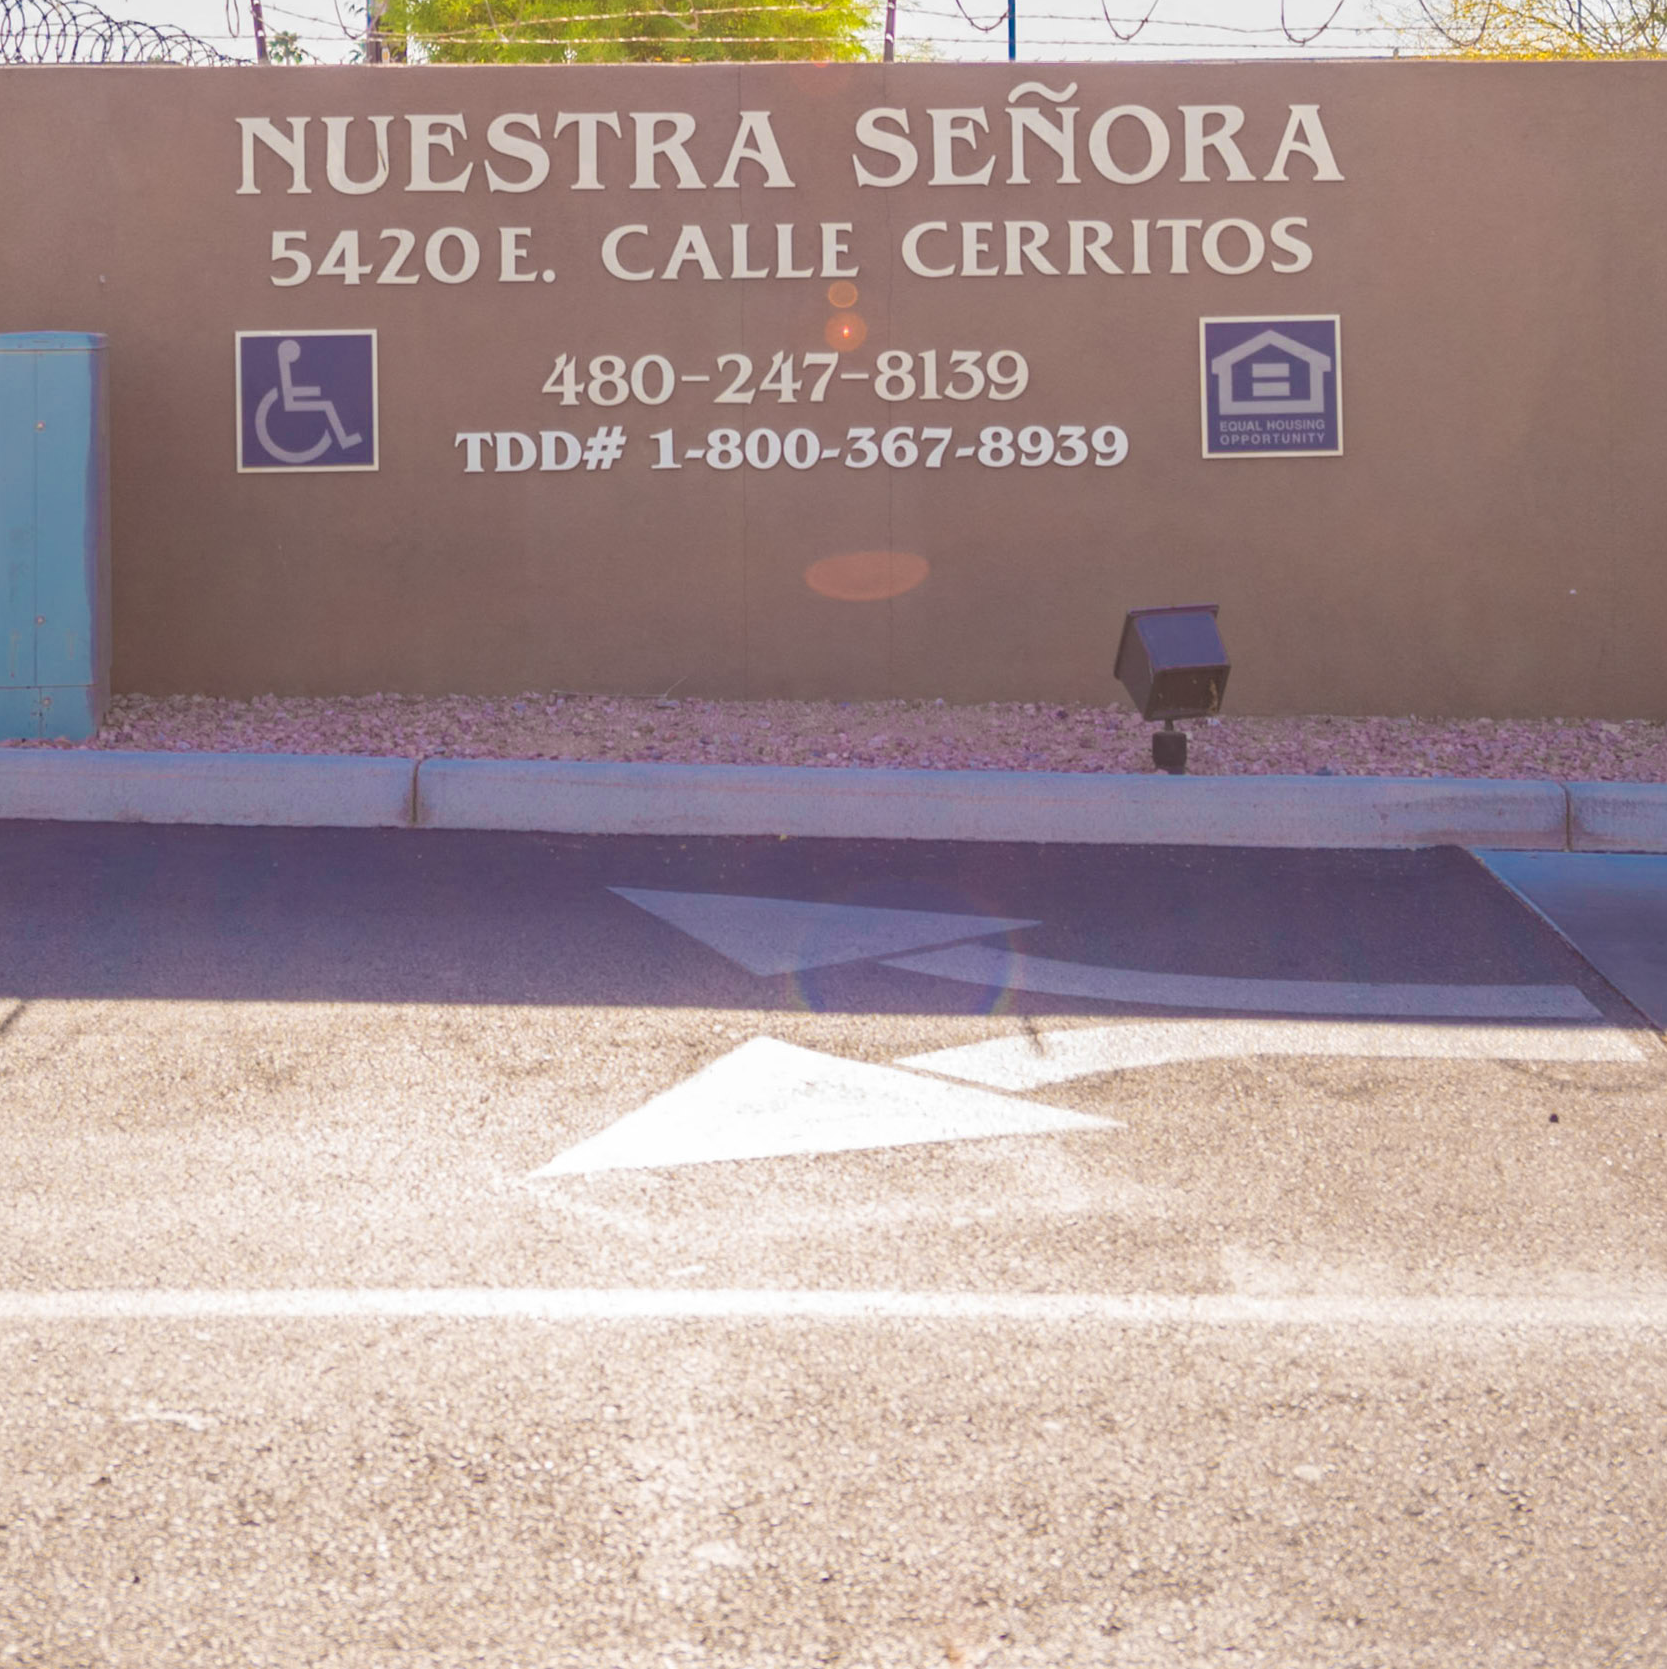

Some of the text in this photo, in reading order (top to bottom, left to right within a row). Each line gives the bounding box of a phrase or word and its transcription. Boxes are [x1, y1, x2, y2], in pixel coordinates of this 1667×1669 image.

[235, 81, 1346, 195] NUESTRA SEÑORA
[601, 223, 860, 281] CALLE
[901, 217, 1314, 278] CERRITOS
[541, 349, 1030, 406] 480-247-8139
[454, 425, 1130, 473] TDD# 1-800-367-8939
[1219, 419, 1325, 432] EQUAL HOUSING
[1219, 433, 1326, 445] OPPORTUNITY
